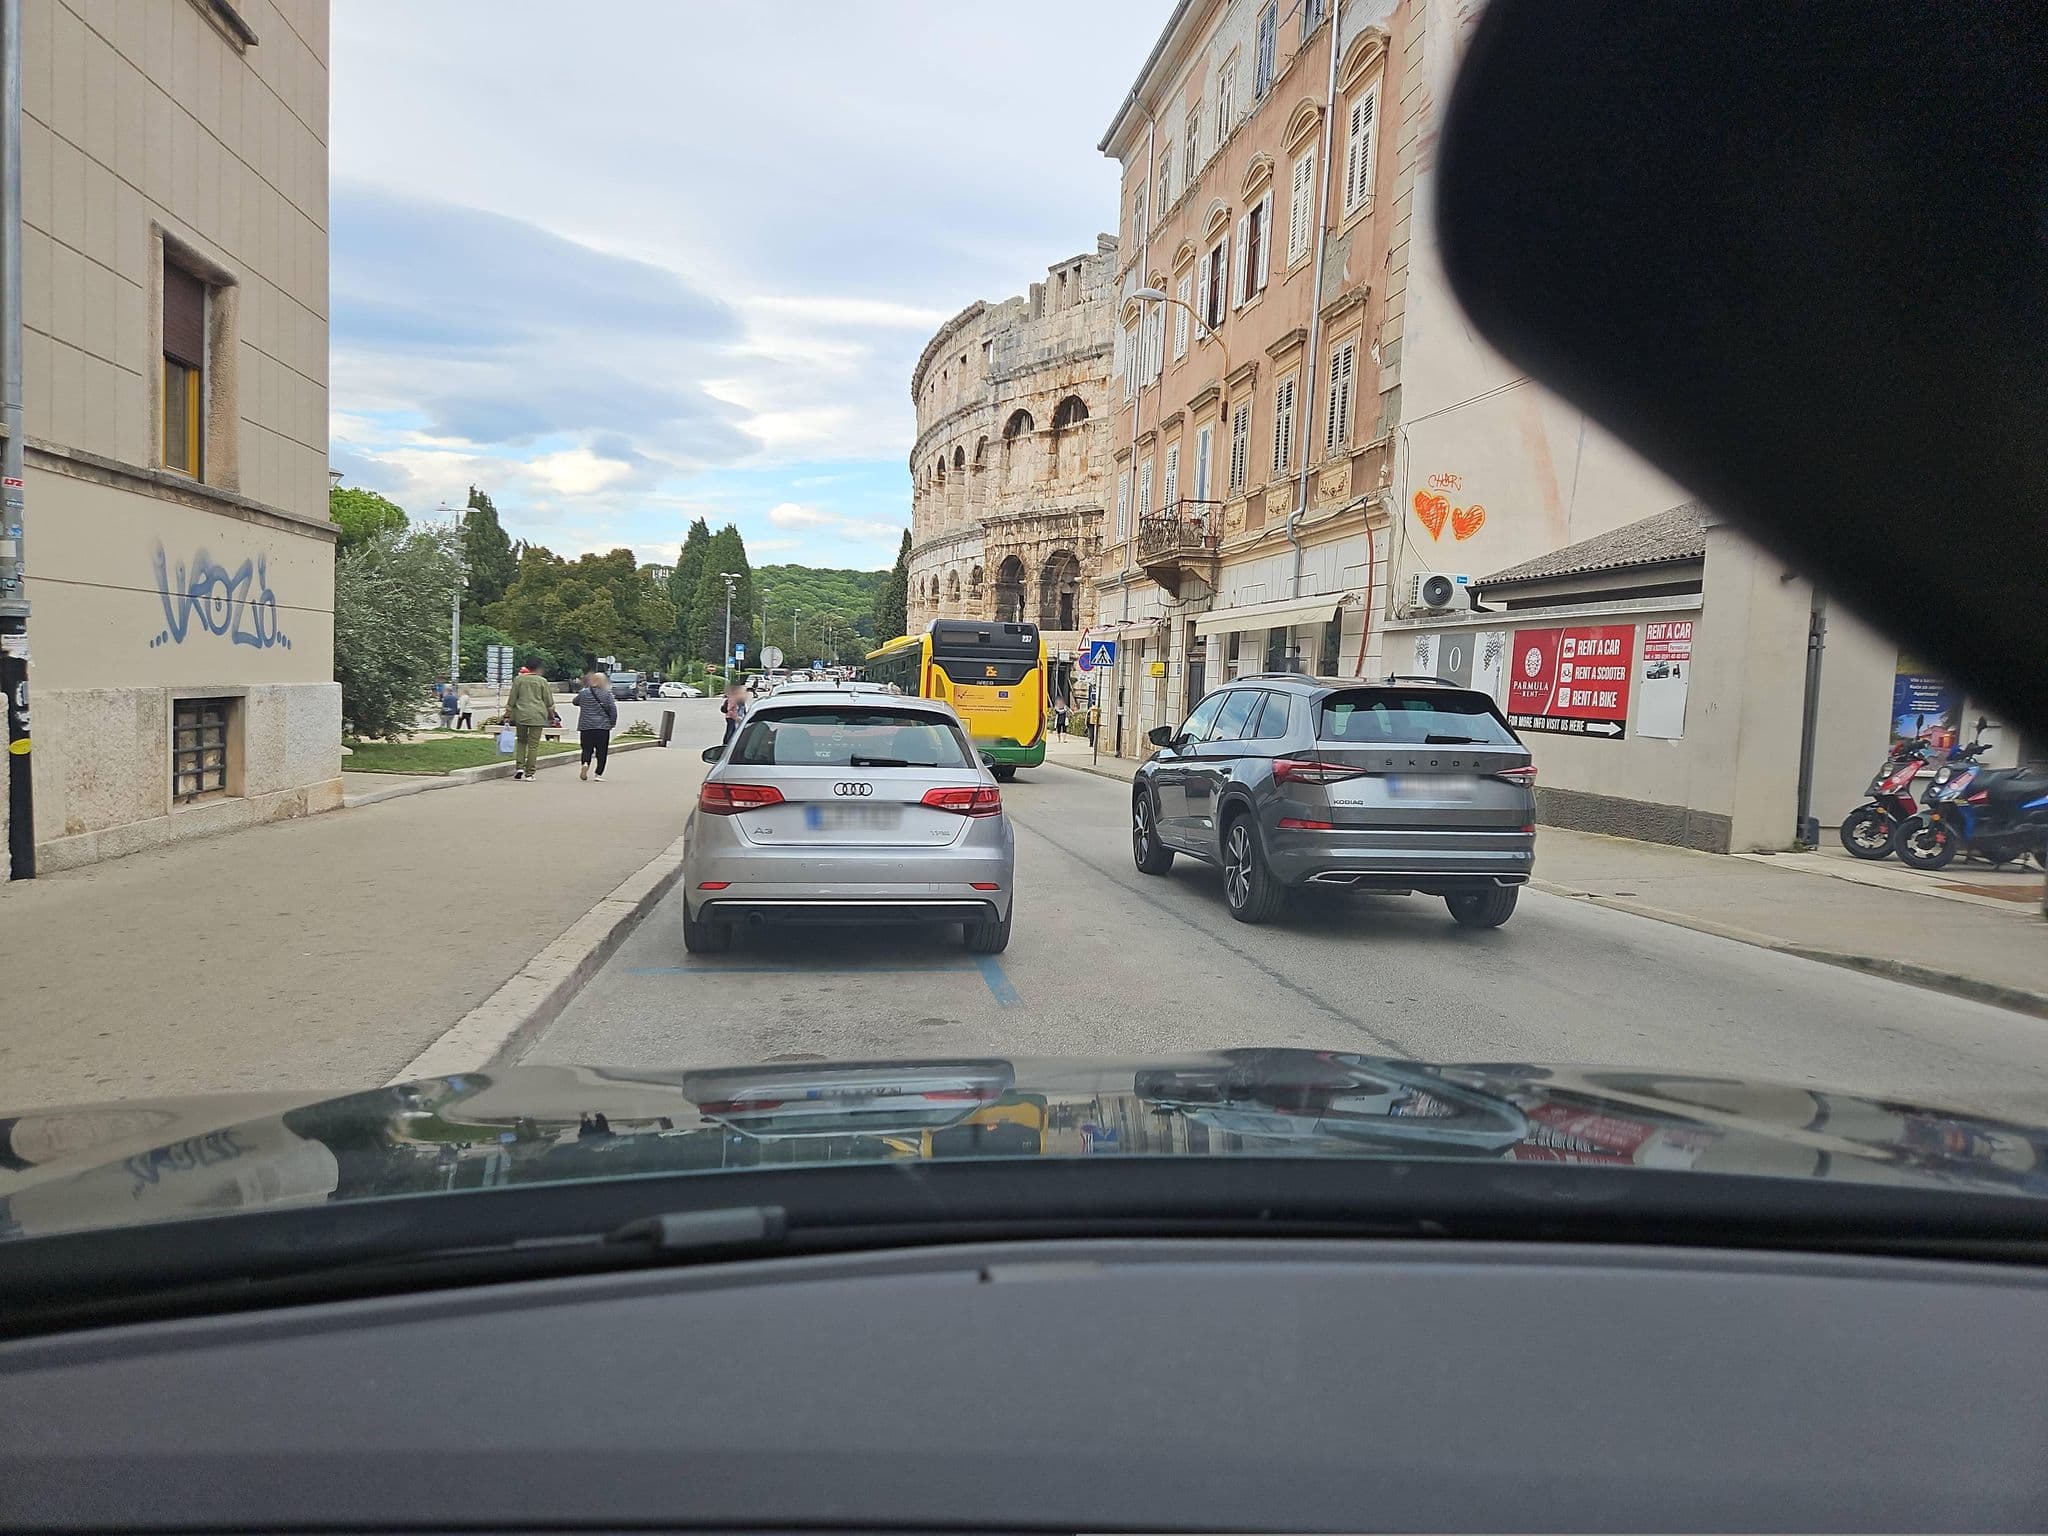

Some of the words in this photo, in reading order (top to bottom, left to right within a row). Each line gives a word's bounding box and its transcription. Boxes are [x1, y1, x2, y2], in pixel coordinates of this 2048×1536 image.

[1646, 624, 1667, 640] RENT
[1666, 624, 1673, 639] A
[1674, 622, 1692, 639] CAR
[1577, 640, 1598, 656] RENT
[1597, 640, 1603, 656] A
[1604, 639, 1621, 655] CAR
[1574, 667, 1592, 680] RENT
[1591, 667, 1597, 680] A
[1597, 667, 1627, 681] SCOOTER
[1513, 681, 1549, 691] PARMULA
[1572, 690, 1593, 706] RENT
[1591, 691, 1598, 707] A
[1599, 692, 1618, 708] BIKE
[1508, 715, 1518, 726] FOR
[1518, 716, 1533, 728] MORE
[1533, 717, 1546, 729] INFO
[1546, 718, 1560, 730] VISIT
[1560, 719, 1569, 731] US
[1569, 720, 1585, 732] HERE
[754, 827, 773, 835] A3
